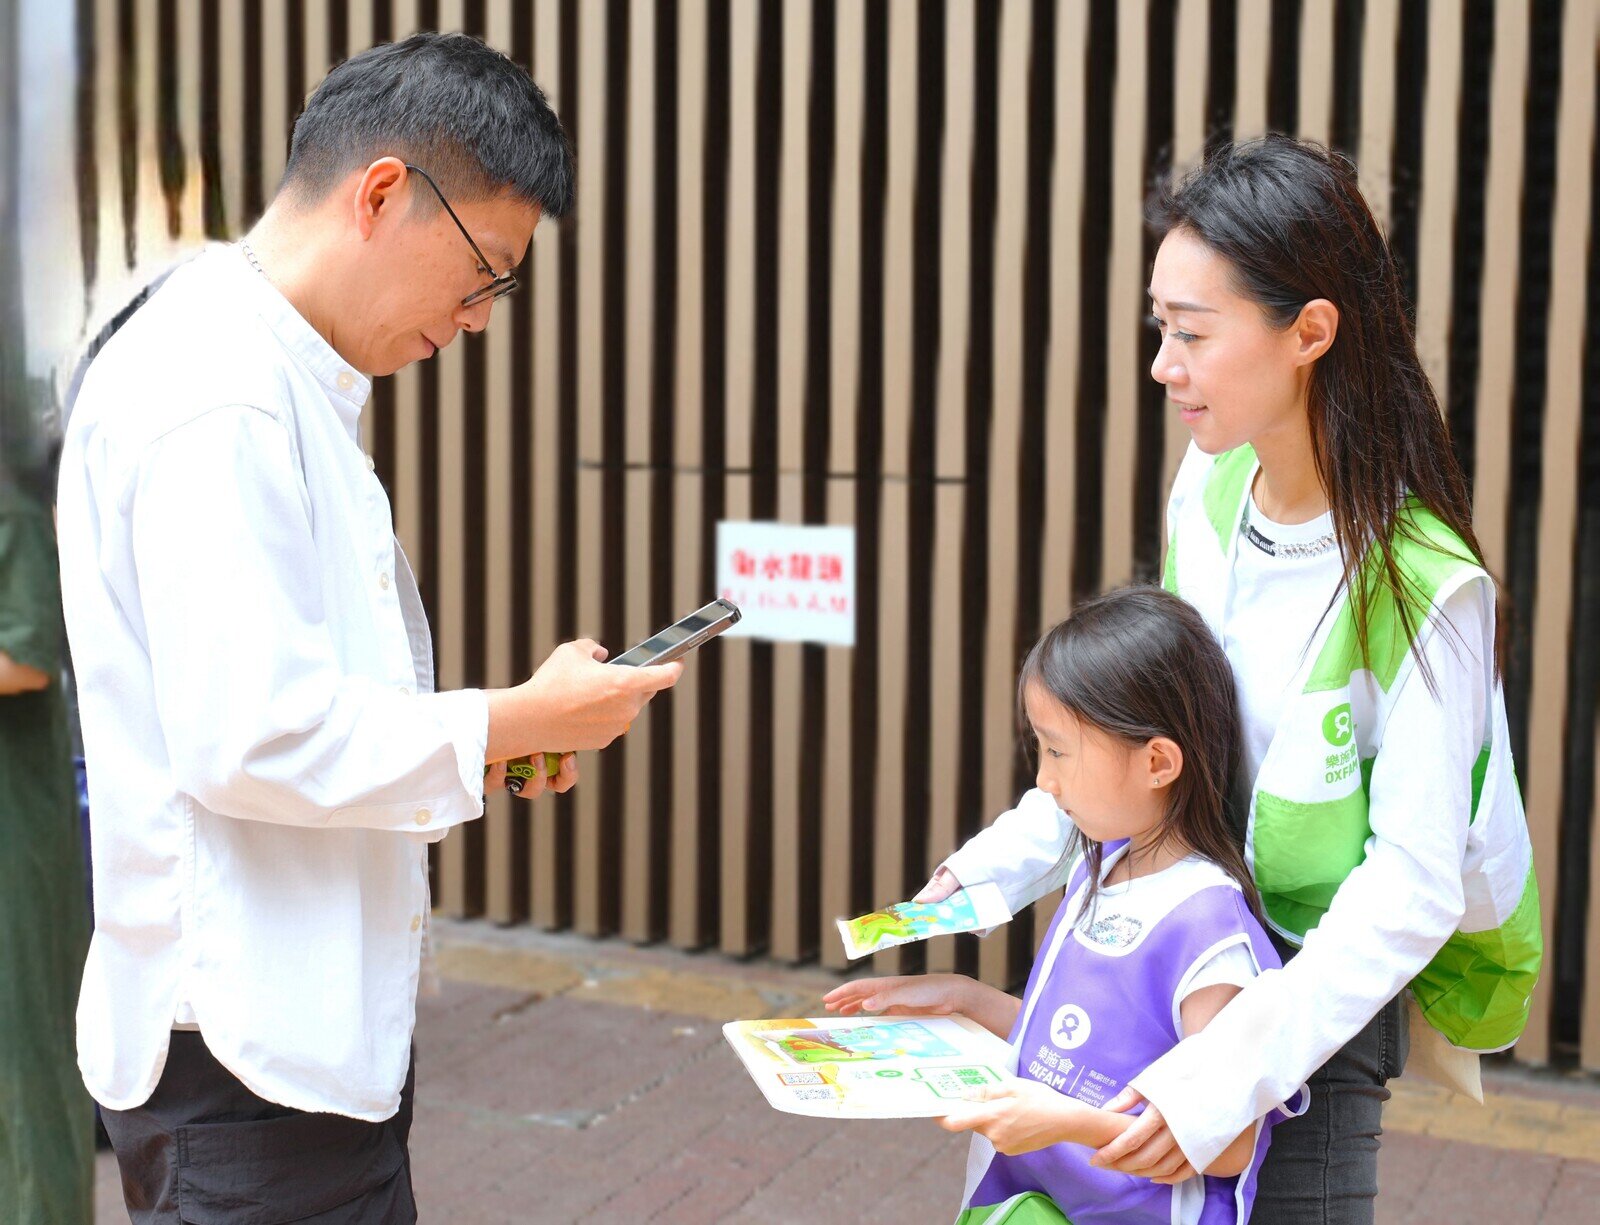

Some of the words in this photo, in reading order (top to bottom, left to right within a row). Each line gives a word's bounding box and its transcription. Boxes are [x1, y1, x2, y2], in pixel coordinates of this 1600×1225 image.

[1325, 757, 1359, 784] OXFAM
[1036, 1044, 1075, 1075] 樂施會
[1028, 1060, 1067, 1090] OXFAM
[1084, 1078, 1102, 1091] World
[1076, 1092, 1101, 1108] Poverty
[1080, 1085, 1105, 1101] Without
